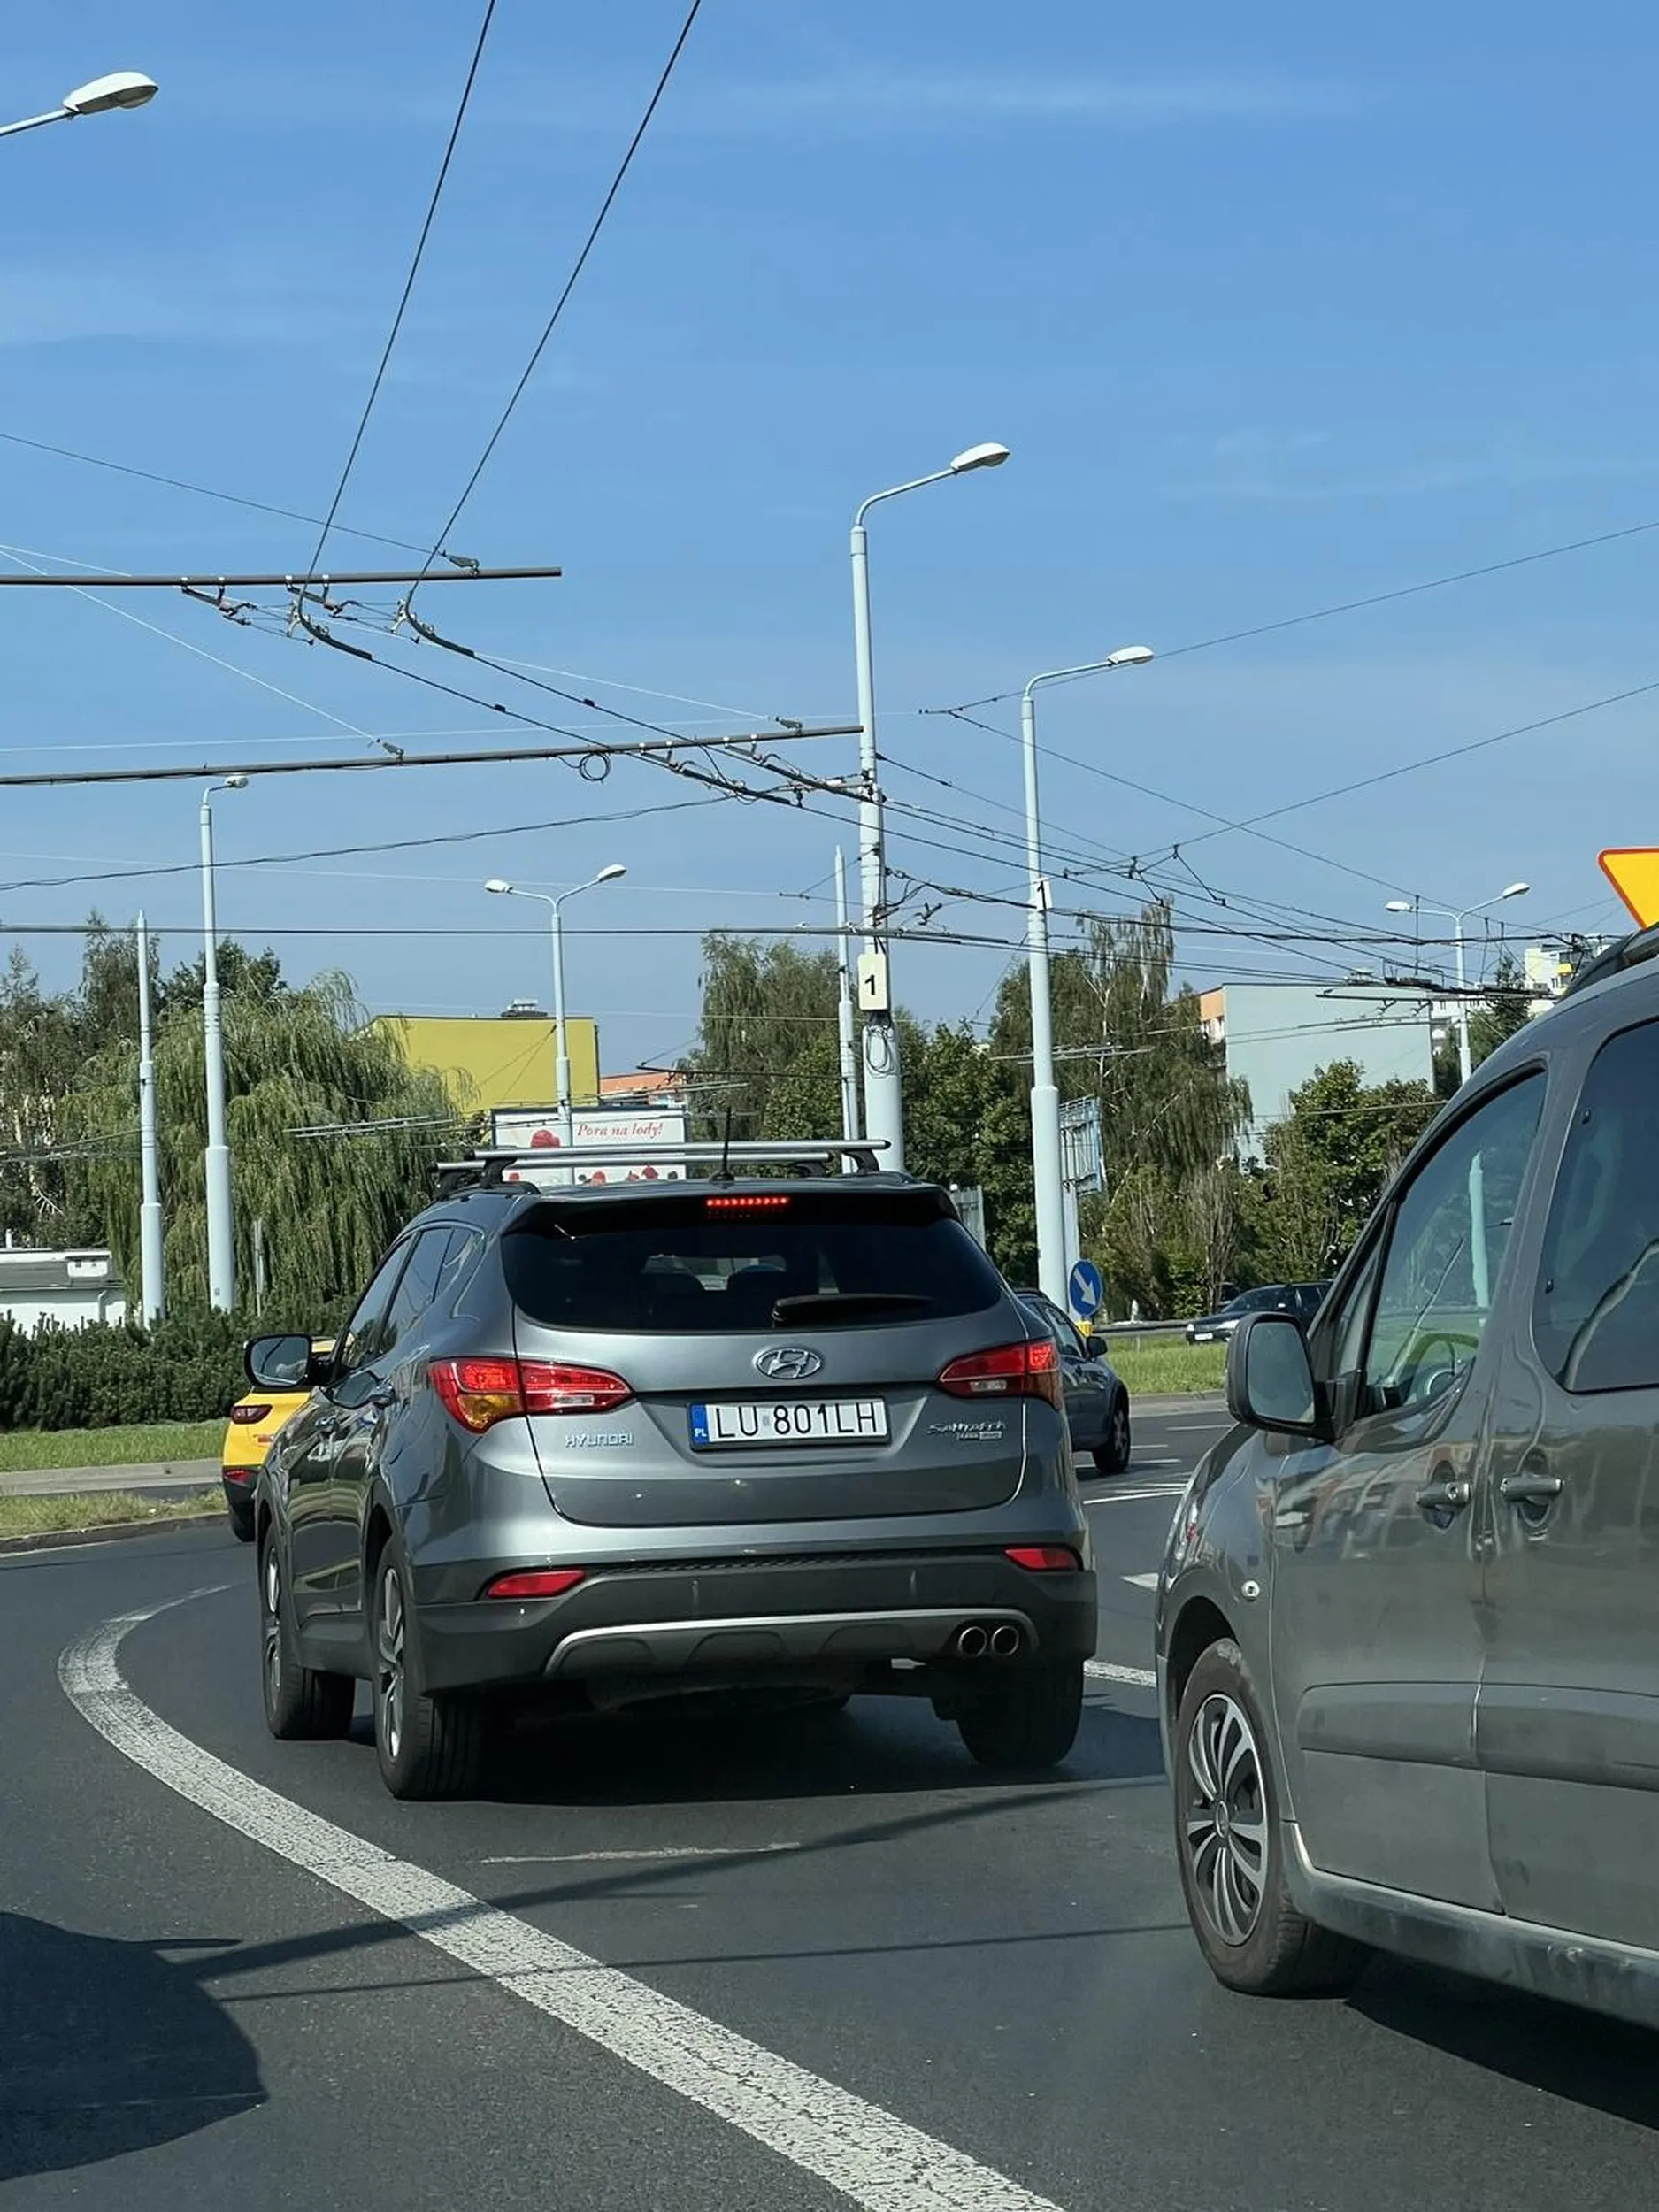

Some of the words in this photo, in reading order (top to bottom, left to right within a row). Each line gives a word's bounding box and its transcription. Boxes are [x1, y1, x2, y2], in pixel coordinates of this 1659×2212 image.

[864, 974, 876, 996] 1
[577, 1124, 607, 1136] Pora
[612, 1127, 628, 1136] na
[632, 1122, 663, 1139] lody!
[715, 1405, 759, 1439] LU
[772, 1402, 878, 1435] 801LH
[695, 1427, 708, 1438] PL
